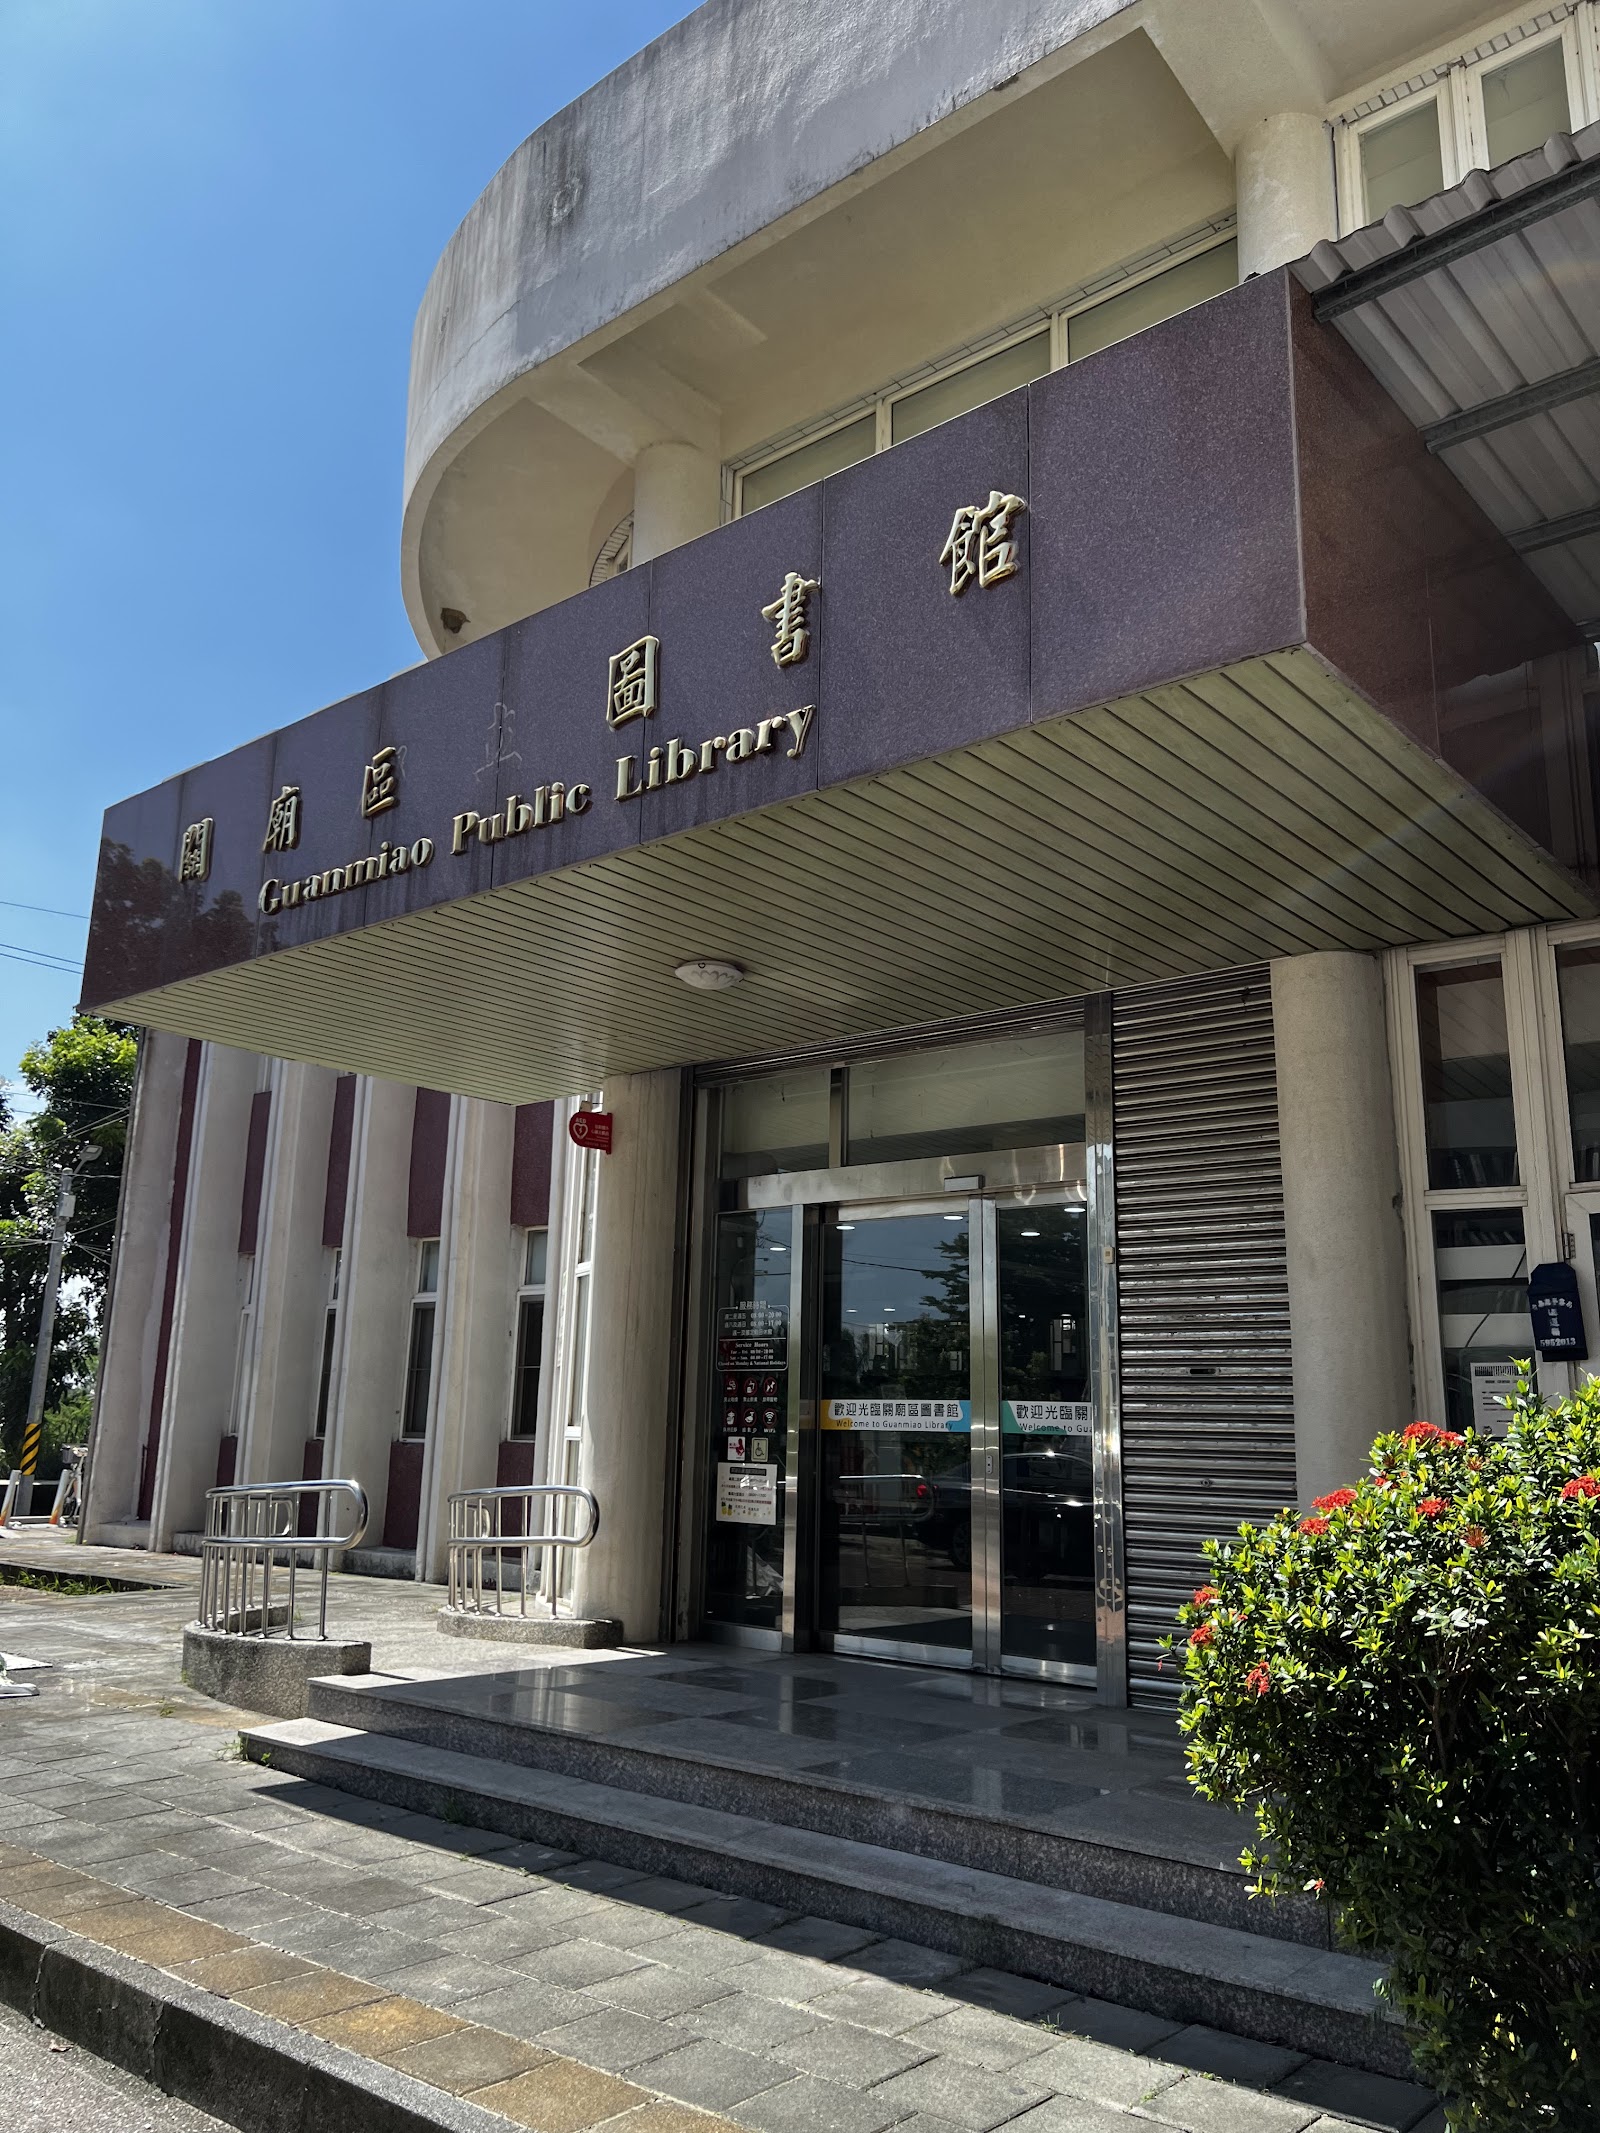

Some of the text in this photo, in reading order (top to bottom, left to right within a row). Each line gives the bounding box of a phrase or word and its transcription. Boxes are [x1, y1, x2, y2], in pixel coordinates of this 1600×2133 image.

[178, 490, 1028, 883] 關廟區圖書館
[258, 703, 817, 916] Guanmiao Public Library
[834, 1402, 959, 1418] 歡迎光臨關廟區圖書館
[1016, 1404, 1093, 1421] 歡迎光臨關
[836, 1419, 953, 1431] Welcome to Guanmiao Library
[1020, 1423, 1060, 1432] Welcome
[1063, 1424, 1073, 1432] to
